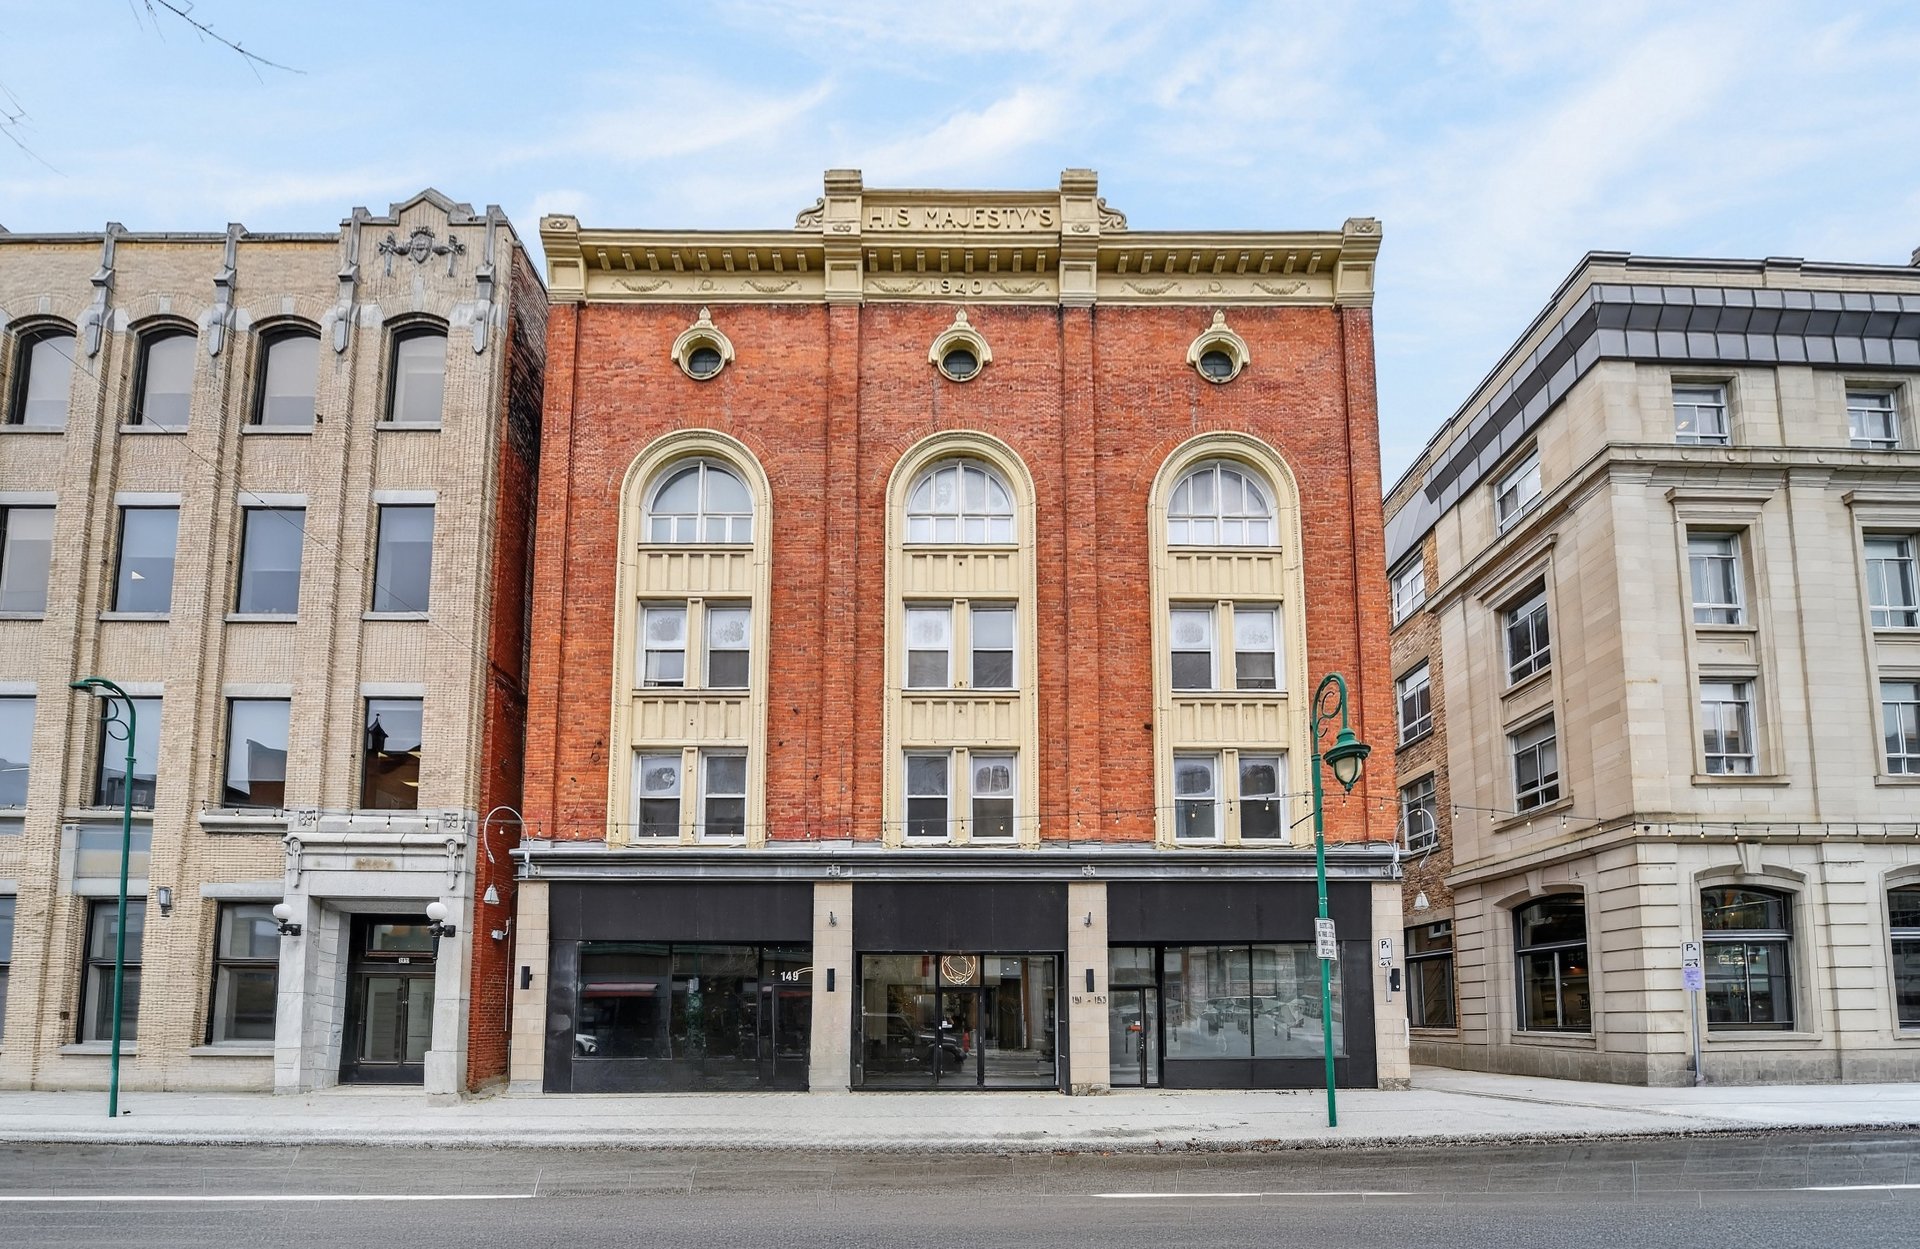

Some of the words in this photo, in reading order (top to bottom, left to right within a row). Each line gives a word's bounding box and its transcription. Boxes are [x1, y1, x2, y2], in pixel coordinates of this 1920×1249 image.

[868, 207, 911, 229] HIS
[924, 207, 1053, 229] MAJESTY'S
[780, 971, 799, 981] 149
